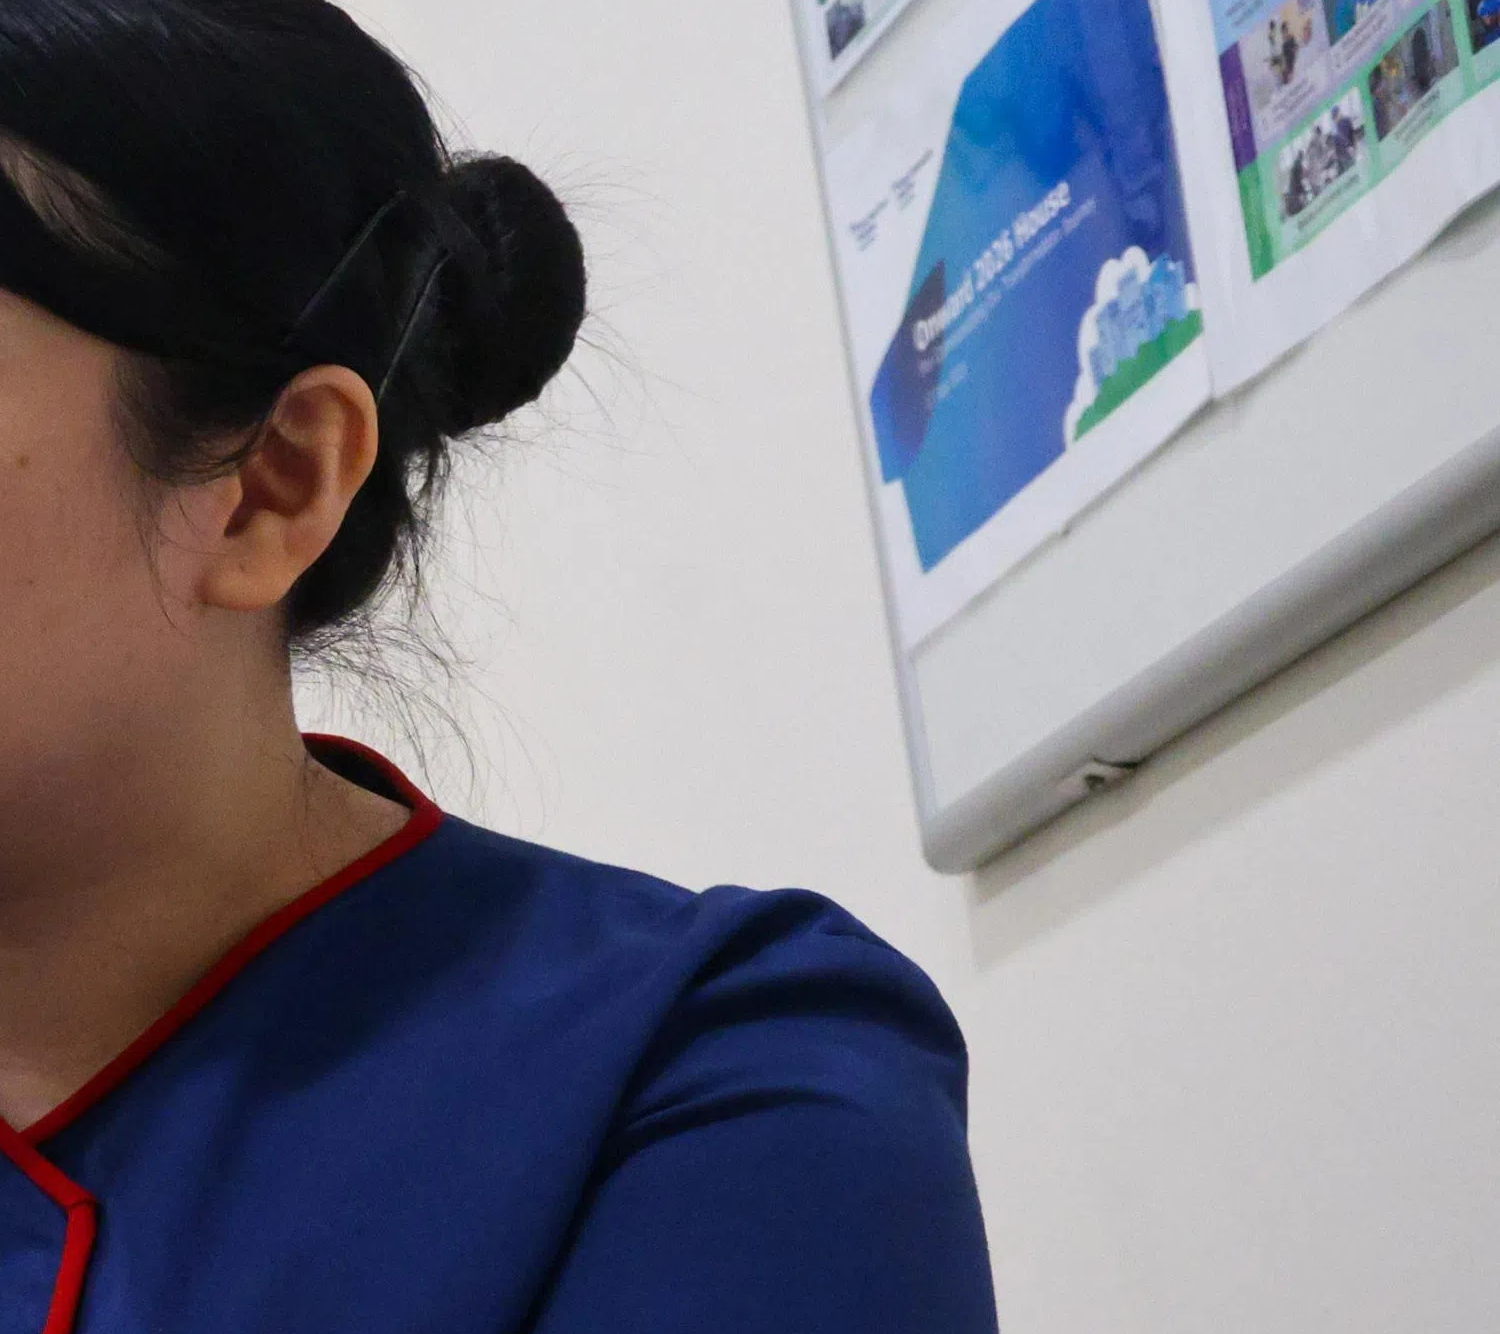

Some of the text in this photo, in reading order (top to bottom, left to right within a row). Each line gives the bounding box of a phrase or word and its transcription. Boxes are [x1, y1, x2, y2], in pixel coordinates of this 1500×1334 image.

[912, 266, 975, 351] Onward
[973, 228, 1014, 292] 2026
[1012, 181, 1071, 249] House
